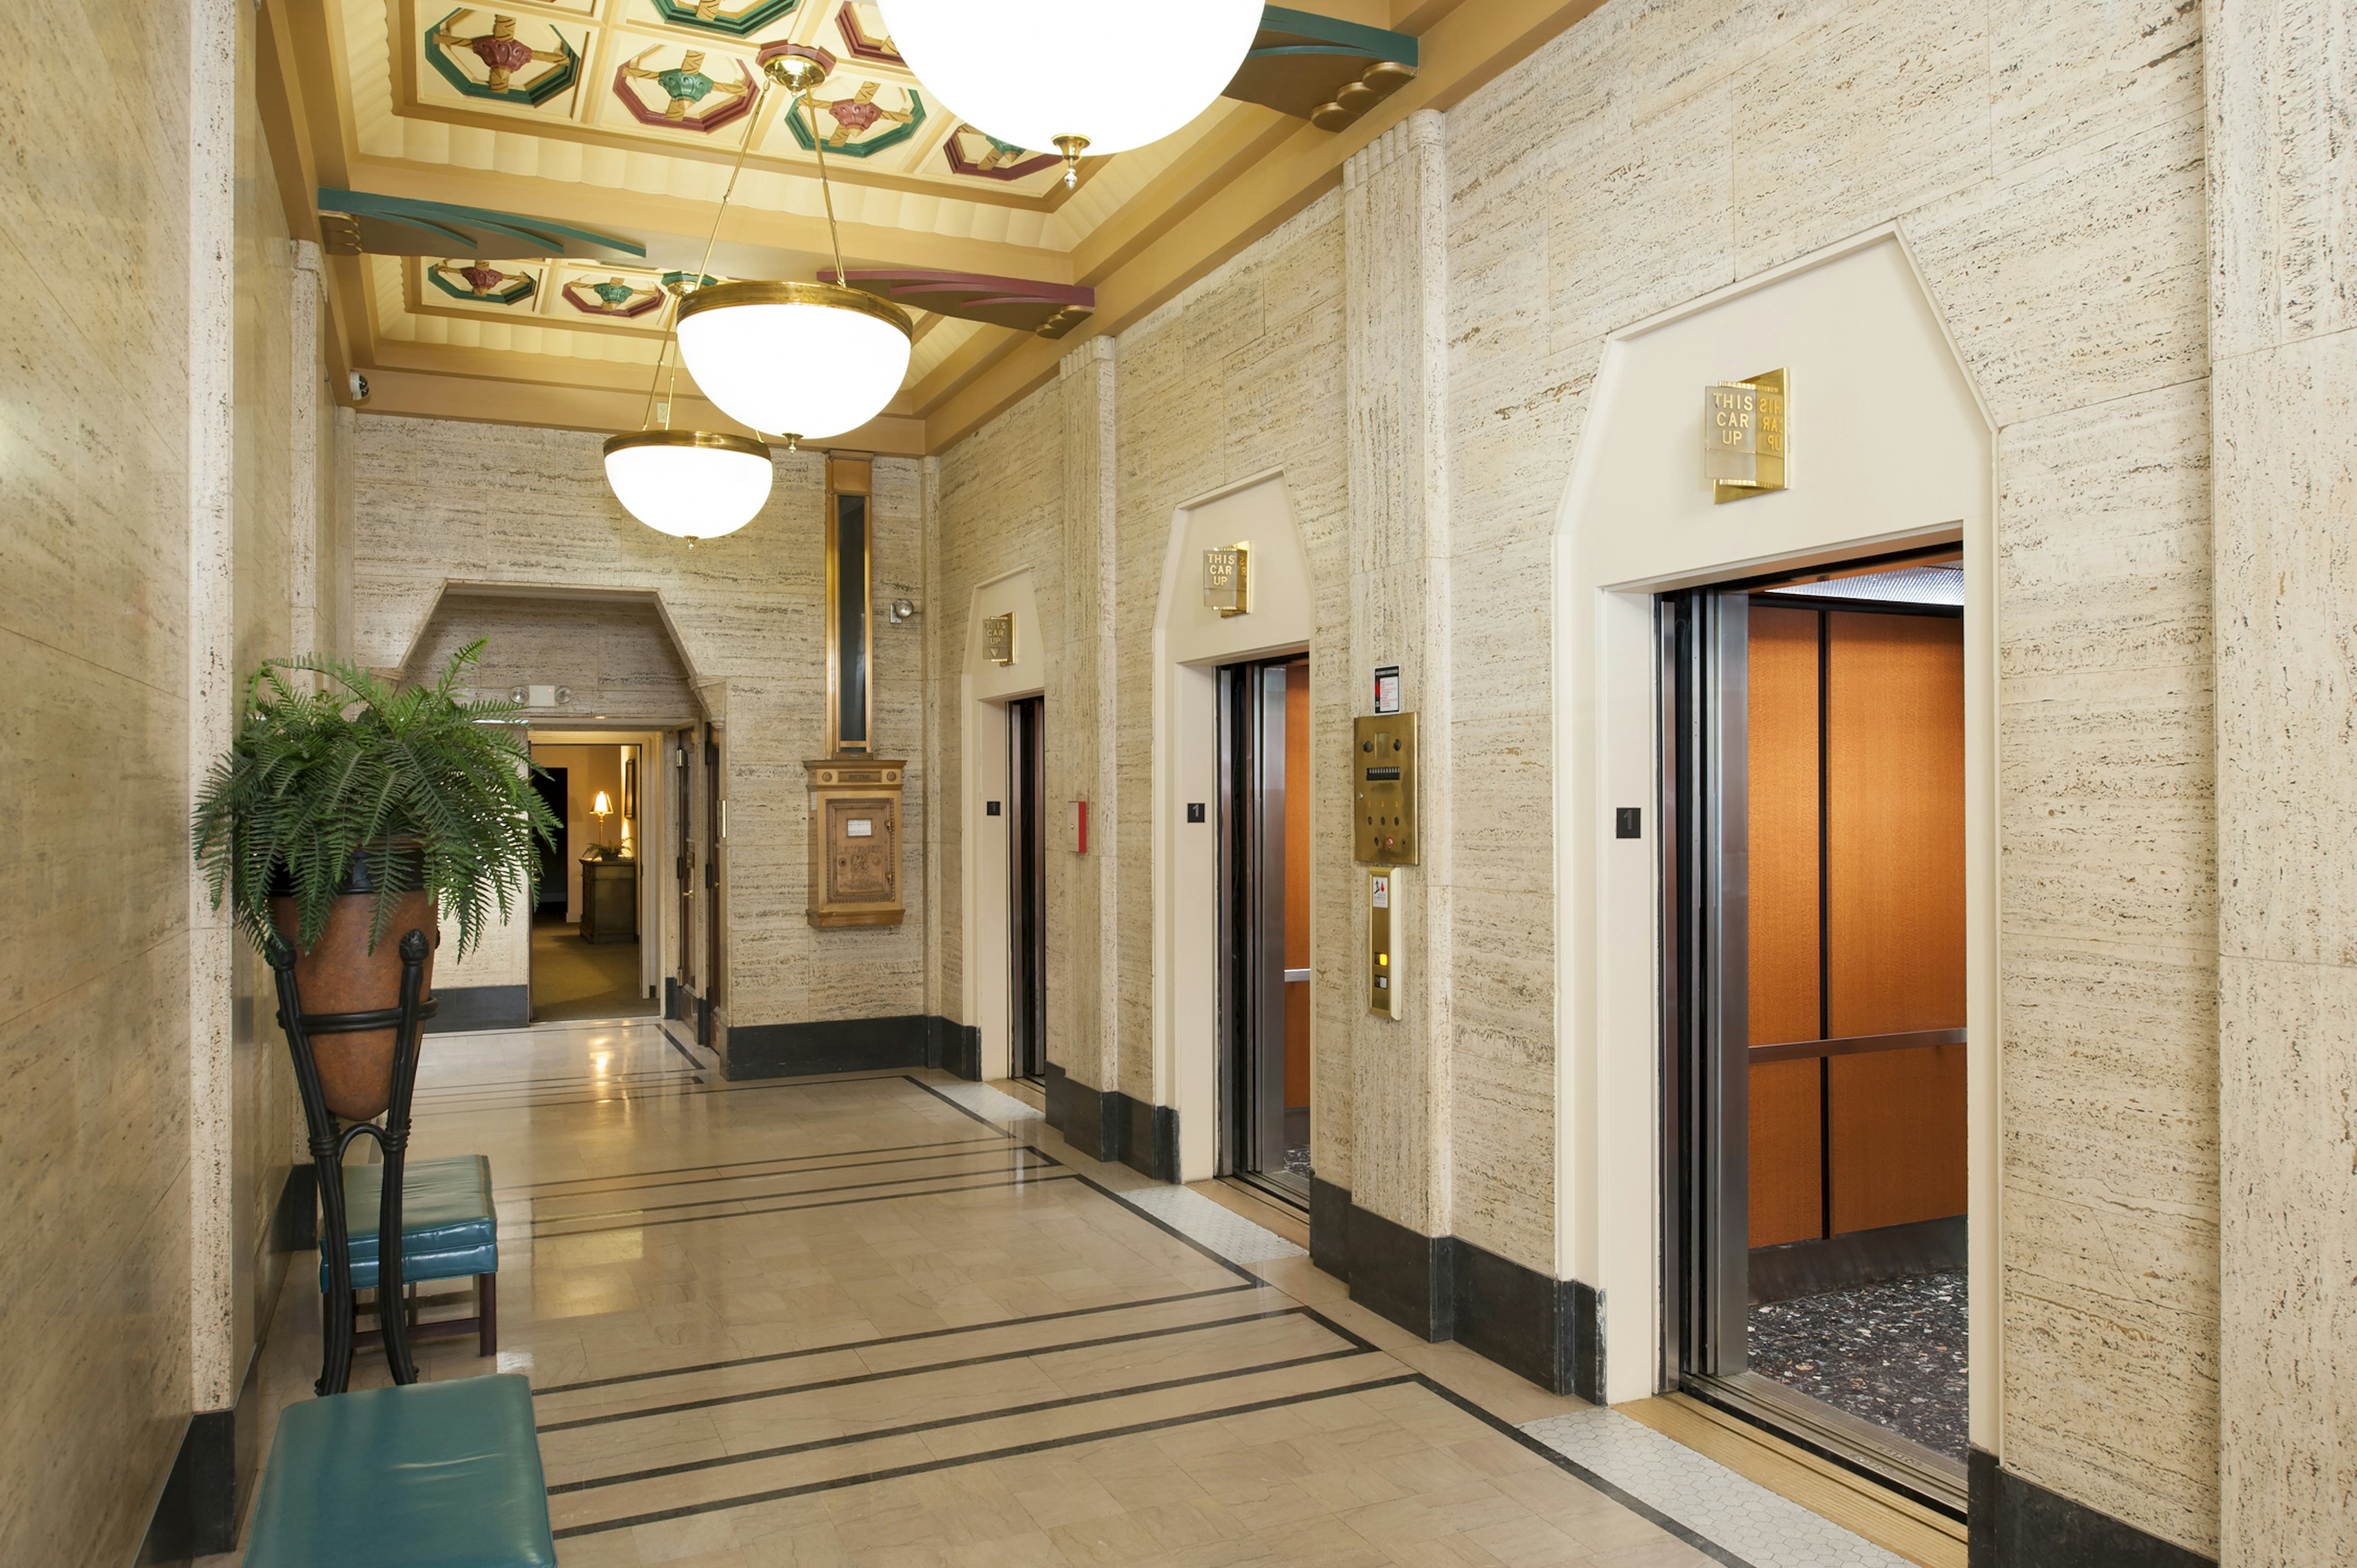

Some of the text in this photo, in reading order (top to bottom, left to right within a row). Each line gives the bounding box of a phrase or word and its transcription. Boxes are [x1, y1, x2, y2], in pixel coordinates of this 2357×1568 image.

[1713, 393, 1753, 411] THIS
[1717, 411, 1749, 428] CAR
[1722, 430, 1743, 446] UP
[1207, 554, 1234, 565] THIS
[1210, 565, 1232, 575] CAR
[1213, 576, 1228, 586] UP
[1192, 804, 1199, 817] 1
[1623, 809, 1632, 830] 1
